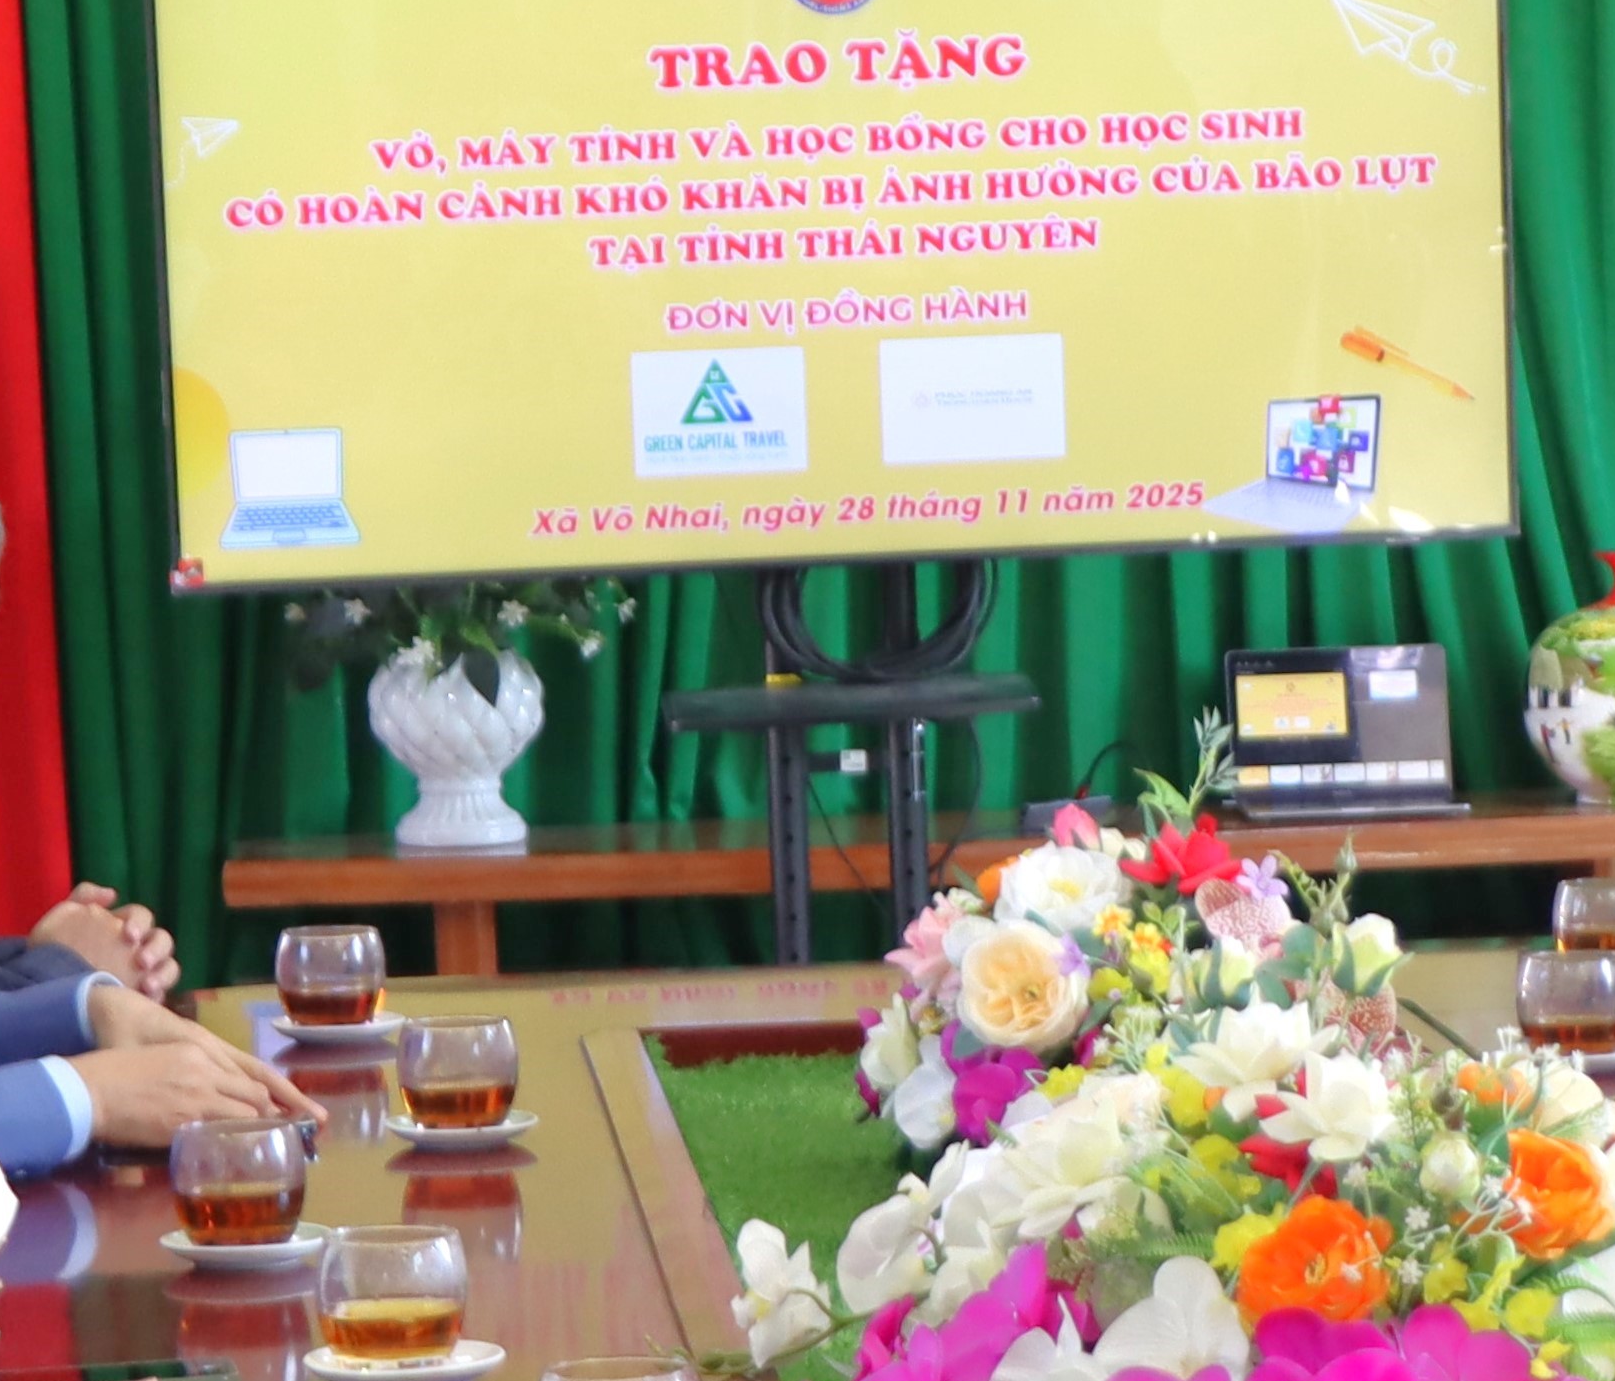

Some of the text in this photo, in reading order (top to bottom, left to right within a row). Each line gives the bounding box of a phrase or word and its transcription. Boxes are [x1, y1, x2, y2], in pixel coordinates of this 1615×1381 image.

[649, 28, 1026, 92] TRAO TẶNG
[1000, 117, 1089, 150] CHO
[1202, 110, 1303, 141] SINH
[644, 430, 788, 452] GREEN CAPITAL TRAVEL
